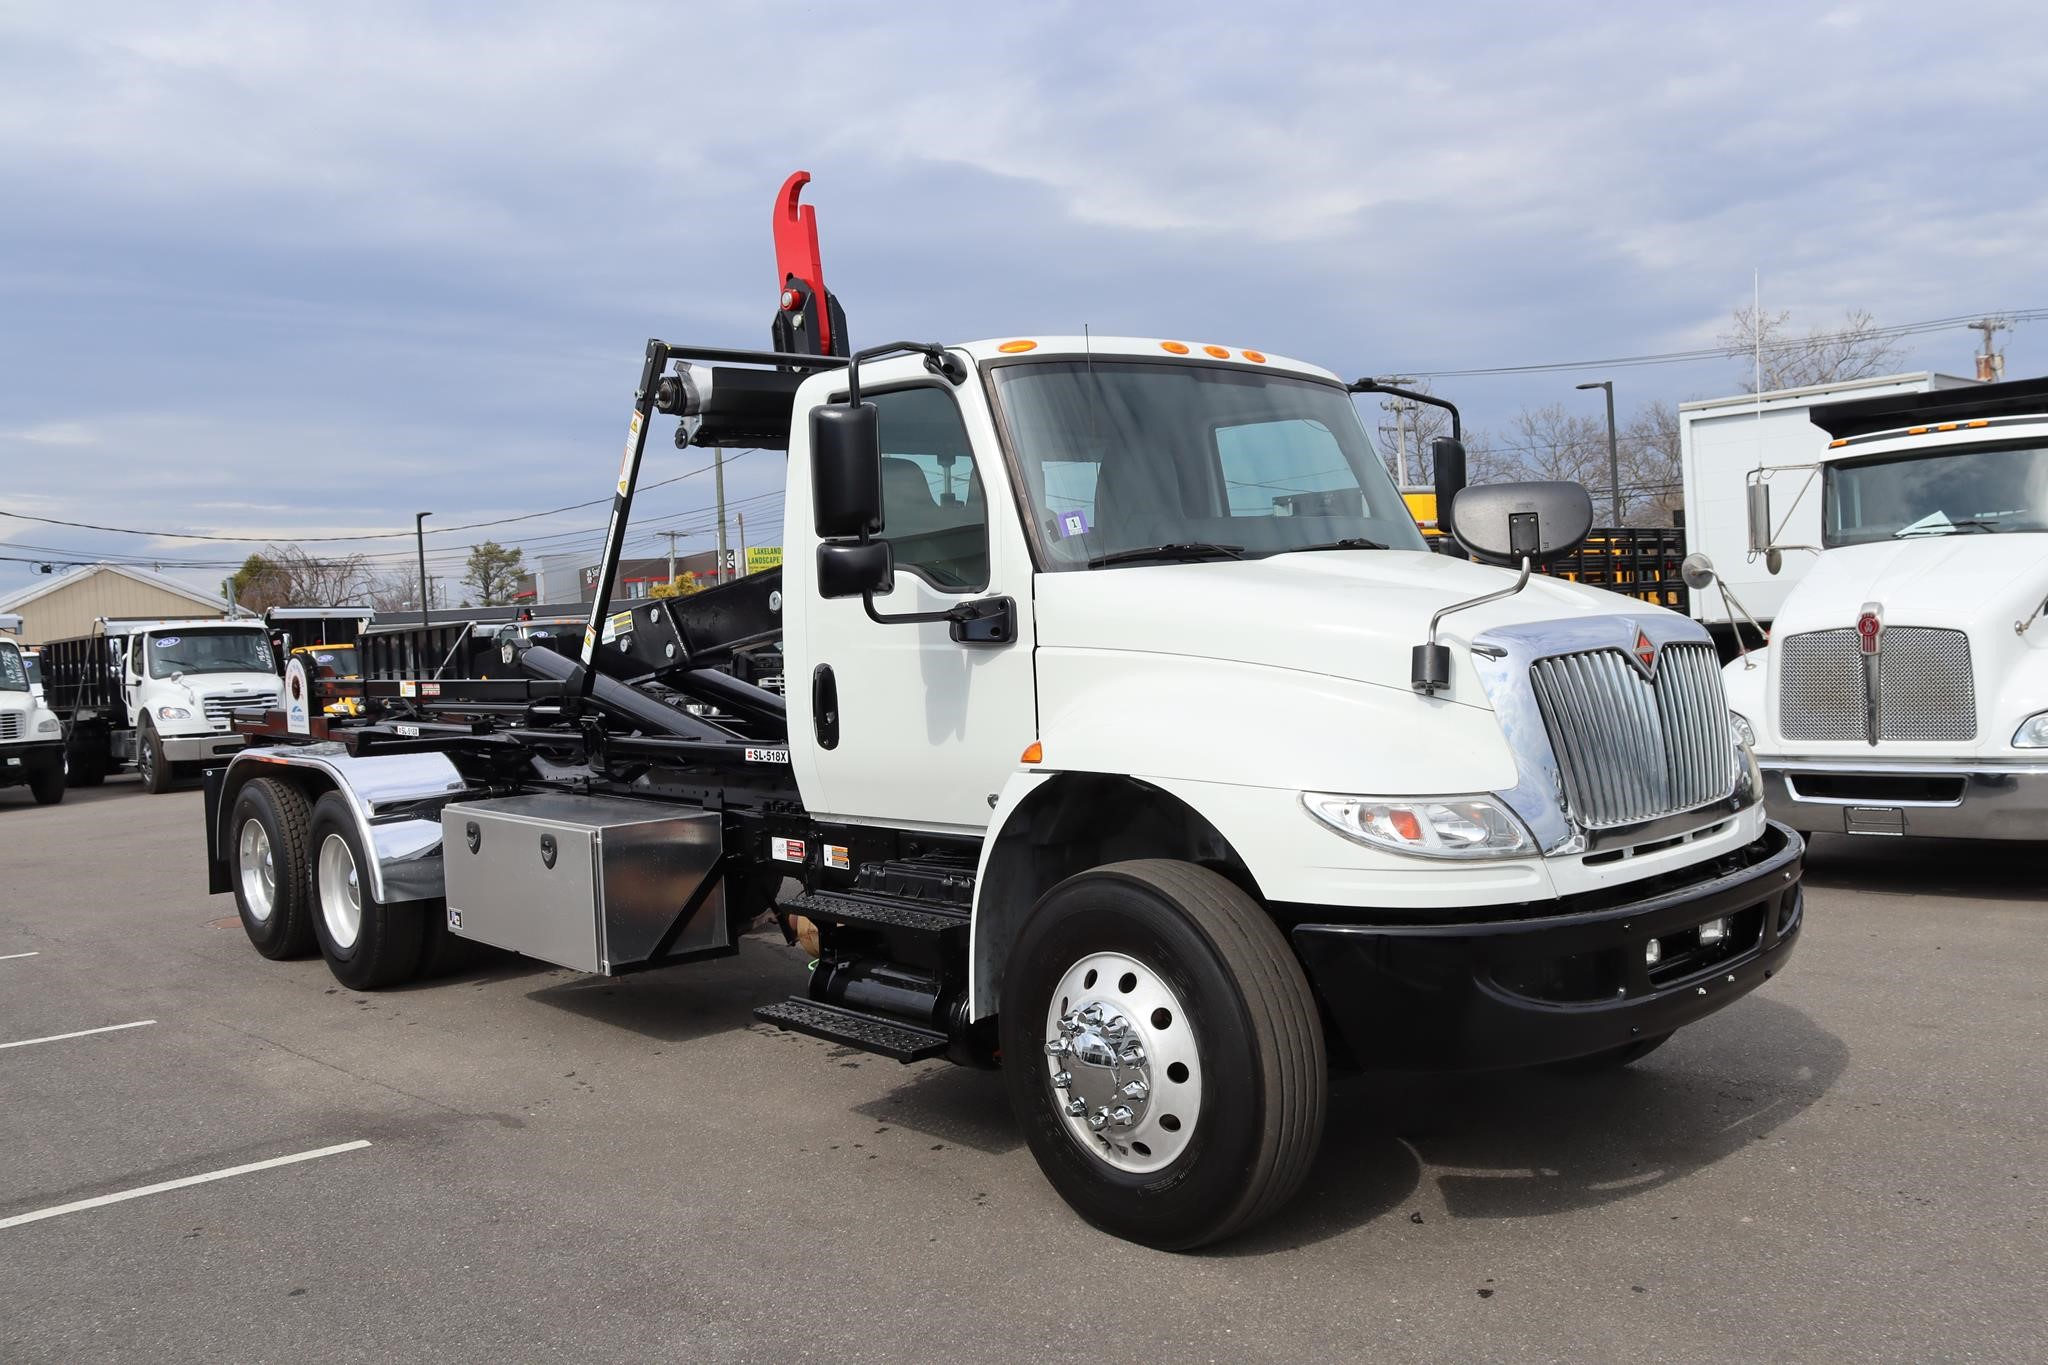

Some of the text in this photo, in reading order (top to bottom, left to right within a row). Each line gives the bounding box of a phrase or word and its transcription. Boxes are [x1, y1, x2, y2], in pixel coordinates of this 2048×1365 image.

[1071, 518, 1078, 529] 1
[753, 547, 782, 556] LAKELAND
[748, 556, 780, 565] LANDSCAPE
[753, 750, 787, 762] SL-518X
